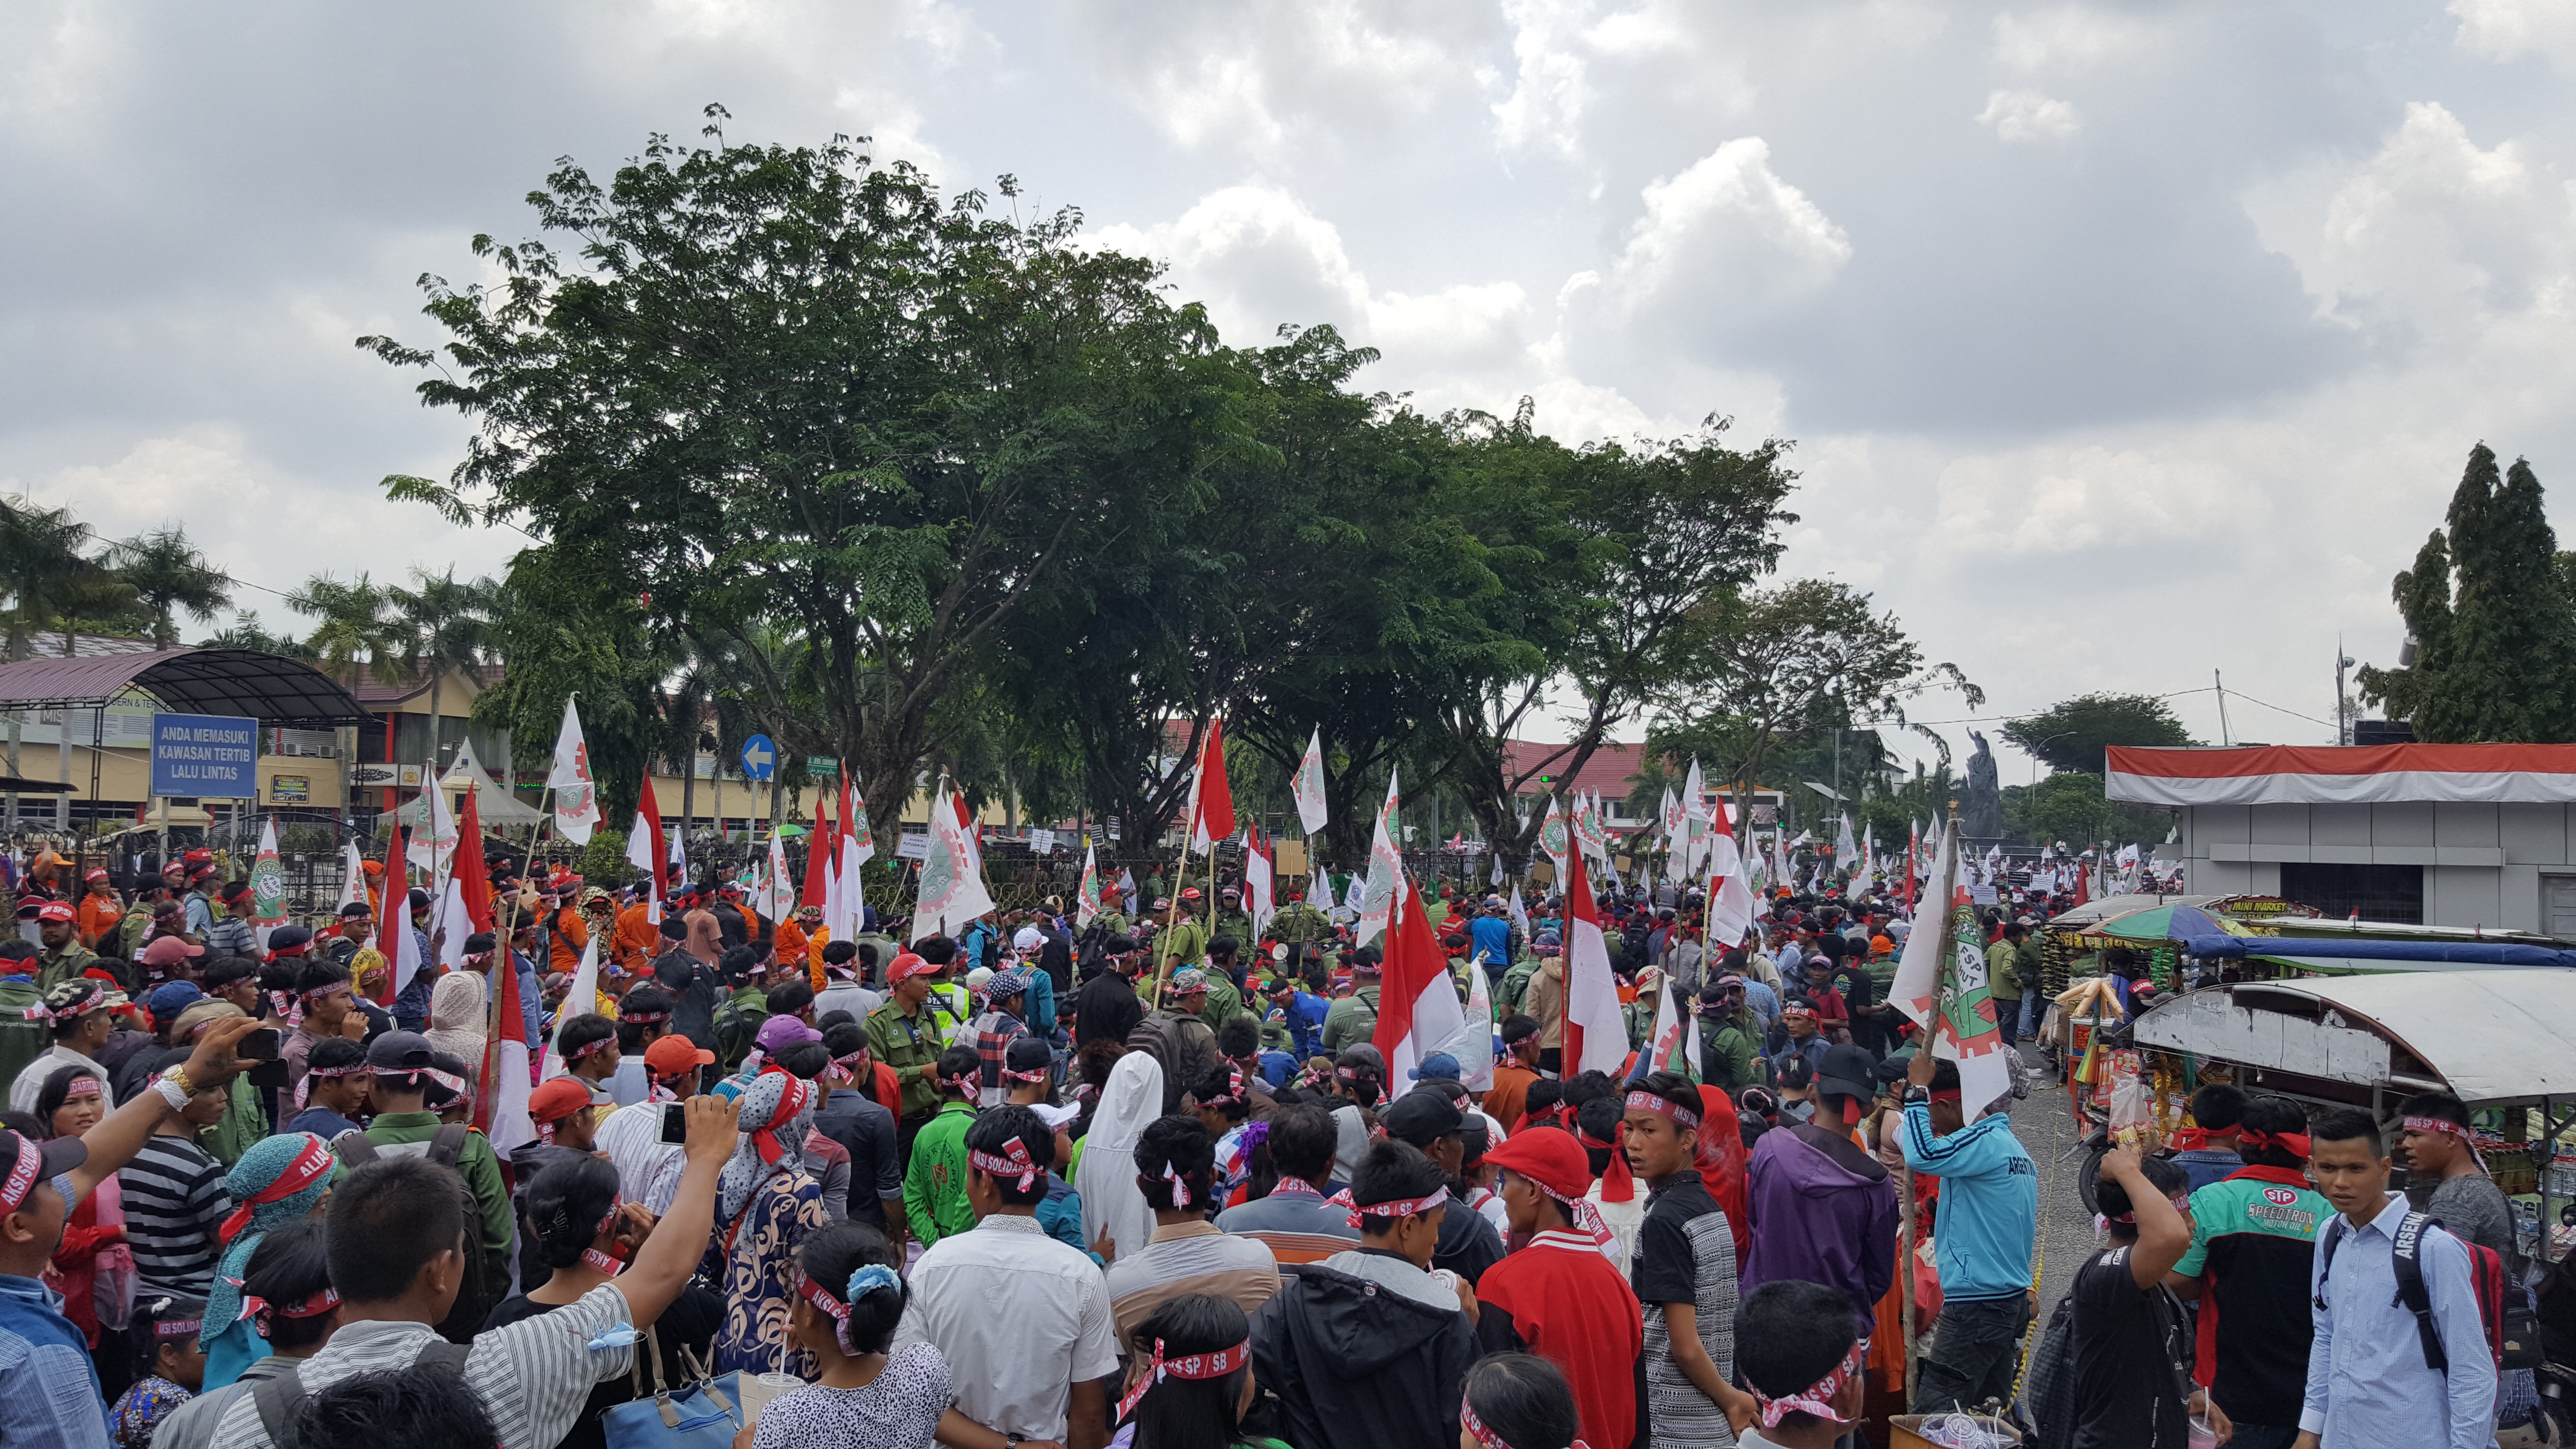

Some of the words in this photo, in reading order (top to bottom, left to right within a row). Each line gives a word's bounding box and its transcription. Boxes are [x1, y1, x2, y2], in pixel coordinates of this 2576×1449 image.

[161, 726, 191, 741] ANDA
[193, 728, 248, 744] MEMASUKI
[159, 746, 211, 760] KAWASAN
[214, 748, 250, 762] TERTIB
[172, 765, 198, 779] LALU
[202, 766, 238, 780] LINTAS
[262, 878, 278, 896] KAHUT
[269, 876, 280, 888] FSP
[2232, 902, 2254, 911] MINI
[2254, 902, 2287, 912] MARKET
[1960, 945, 1982, 972] FSP
[311, 987, 323, 997] AKSI
[1633, 1094, 1644, 1106] SP
[1650, 1097, 1663, 1111] SB
[1673, 1105, 1689, 1122] AKSI
[2423, 1118, 2432, 1129] SP
[2439, 1122, 2449, 1131] SB
[973, 1151, 987, 1168] AKSI
[1, 1173, 27, 1206] AKSI
[2268, 1190, 2292, 1203] STP
[1377, 1205, 1390, 1216] SP
[2248, 1203, 2315, 1225] SPEEDTRON
[2264, 1219, 2287, 1229] MOTOR
[2289, 1222, 2301, 1231] OIL
[798, 1269, 807, 1288] SB
[812, 1289, 835, 1314] AKSI
[1185, 1357, 1201, 1375] SP
[1212, 1352, 1227, 1372] SB
[1819, 1376, 1836, 1398] SP
[1842, 1353, 1855, 1378] SB
